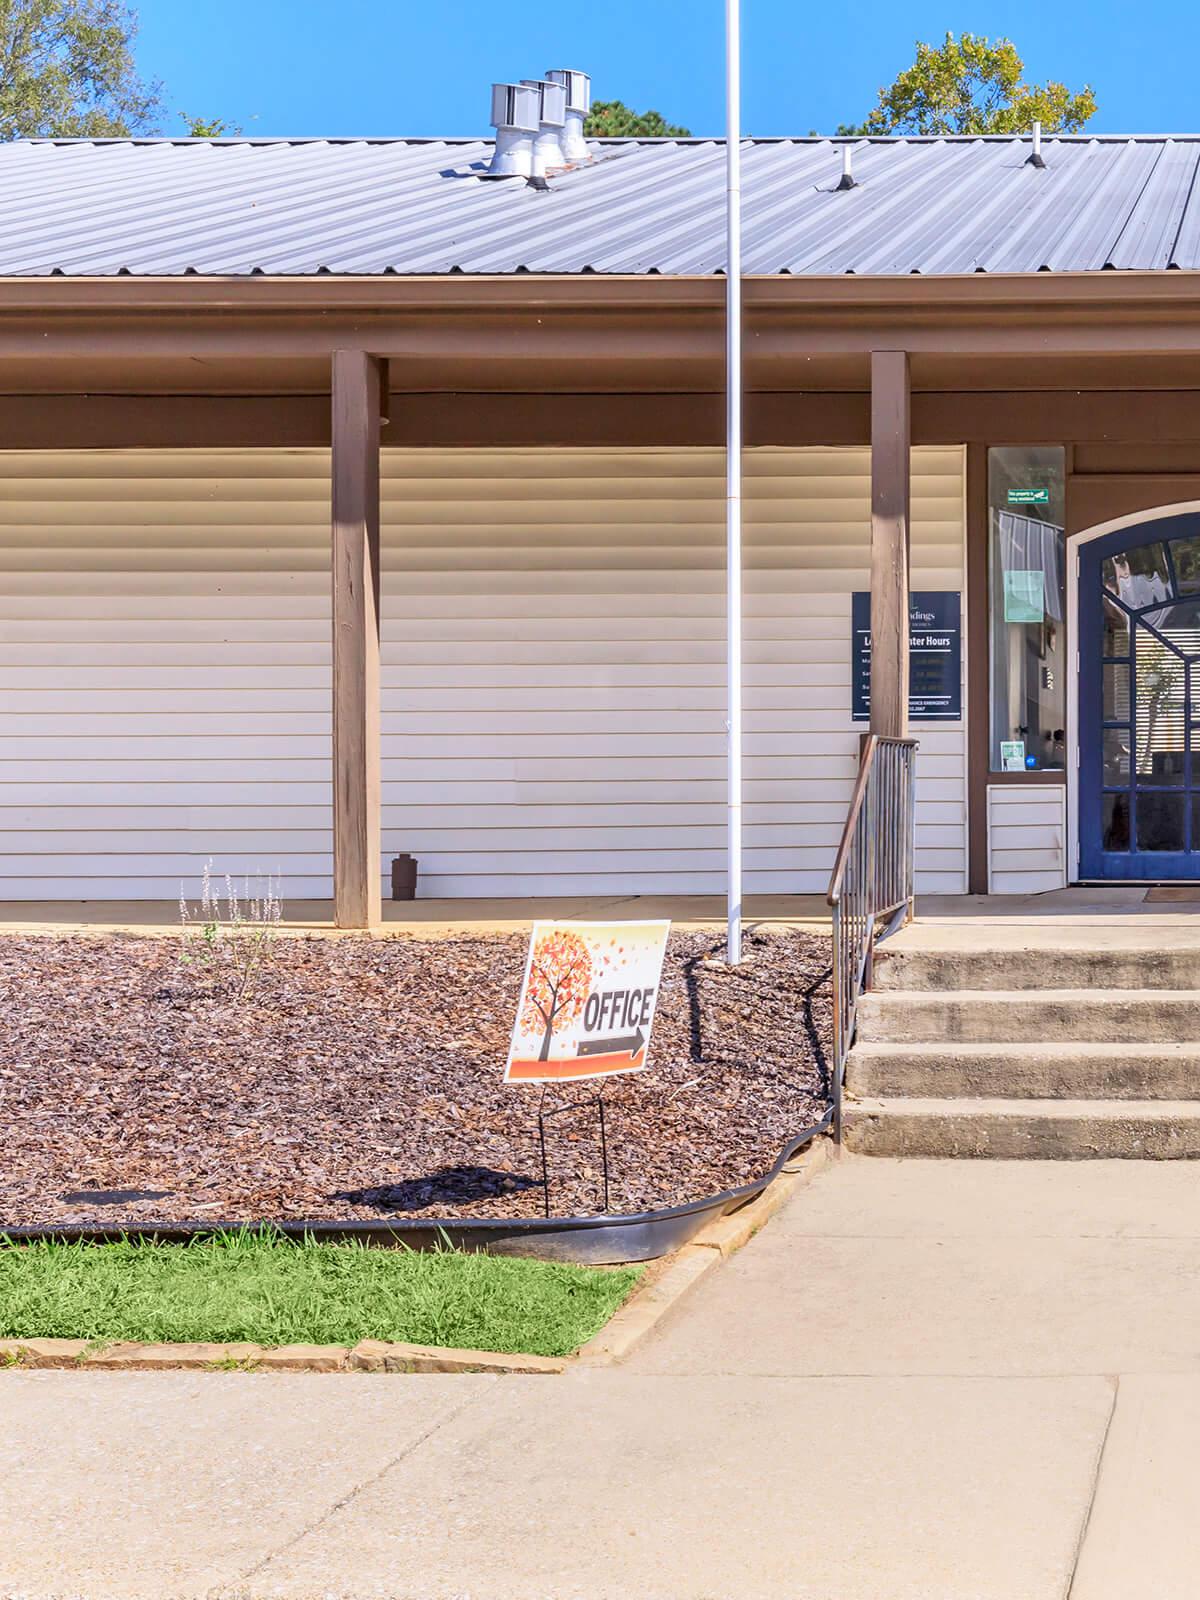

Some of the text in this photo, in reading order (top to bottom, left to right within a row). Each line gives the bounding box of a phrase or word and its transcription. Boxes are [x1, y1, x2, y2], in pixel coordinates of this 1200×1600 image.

[910, 611, 935, 621] ndings
[909, 636, 951, 646] nter Hours
[583, 988, 655, 1033] OFFICE
